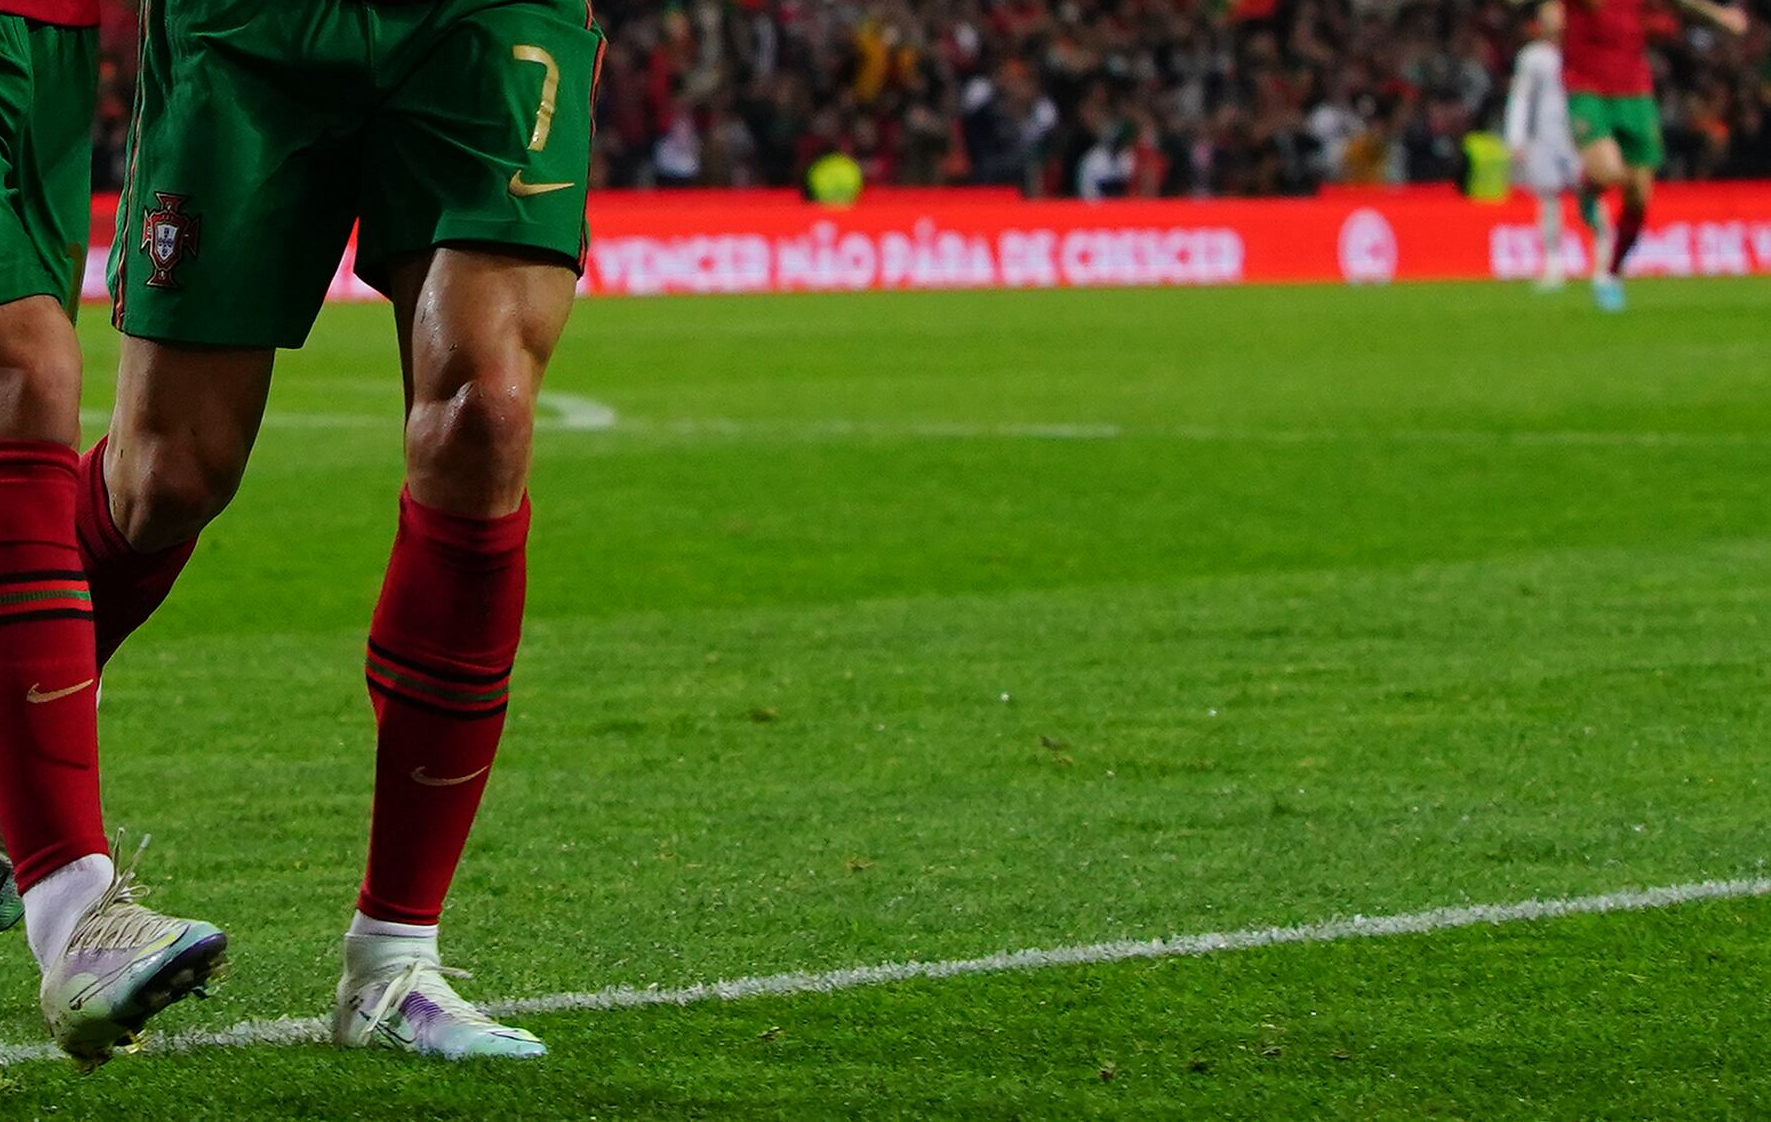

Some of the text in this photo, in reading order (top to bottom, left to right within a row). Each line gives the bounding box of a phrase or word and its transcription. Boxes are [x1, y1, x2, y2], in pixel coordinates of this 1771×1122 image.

[512, 43, 560, 152] 7
[592, 235, 770, 294] VENCER
[997, 228, 1055, 288] DE
[1059, 228, 1244, 285] CRESCER
